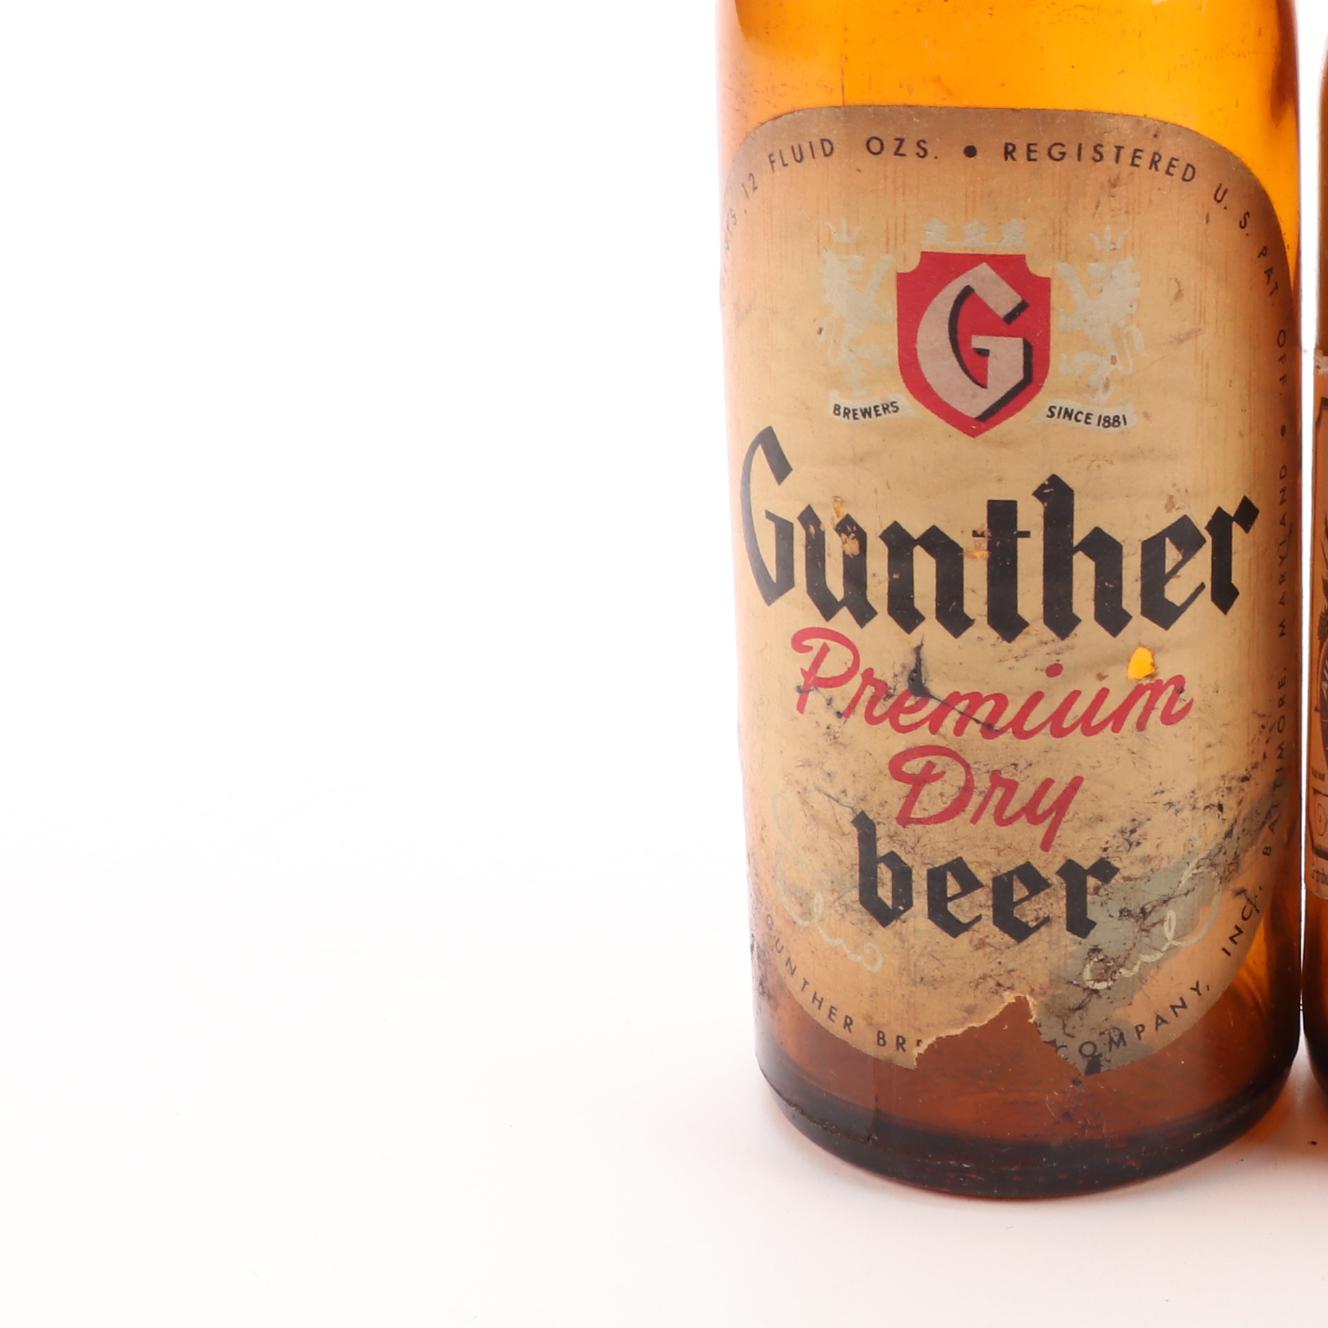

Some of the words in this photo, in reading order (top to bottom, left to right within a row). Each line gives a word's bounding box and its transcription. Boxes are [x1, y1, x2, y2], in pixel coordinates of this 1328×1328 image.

[741, 172, 758, 199] 12
[768, 138, 834, 172] FLUID
[866, 136, 939, 161] OZS.
[1003, 142, 1197, 183] REGISTERED
[916, 262, 1030, 421] G
[833, 401, 899, 421] BREWERS
[1046, 405, 1093, 425] SINCE
[1097, 414, 1128, 429] 1881
[740, 425, 1259, 643] Gunther
[791, 627, 1194, 741] Premium
[888, 744, 1084, 852] Dry
[851, 811, 1120, 943] beer
[766, 914, 853, 1033] GUNTHER
